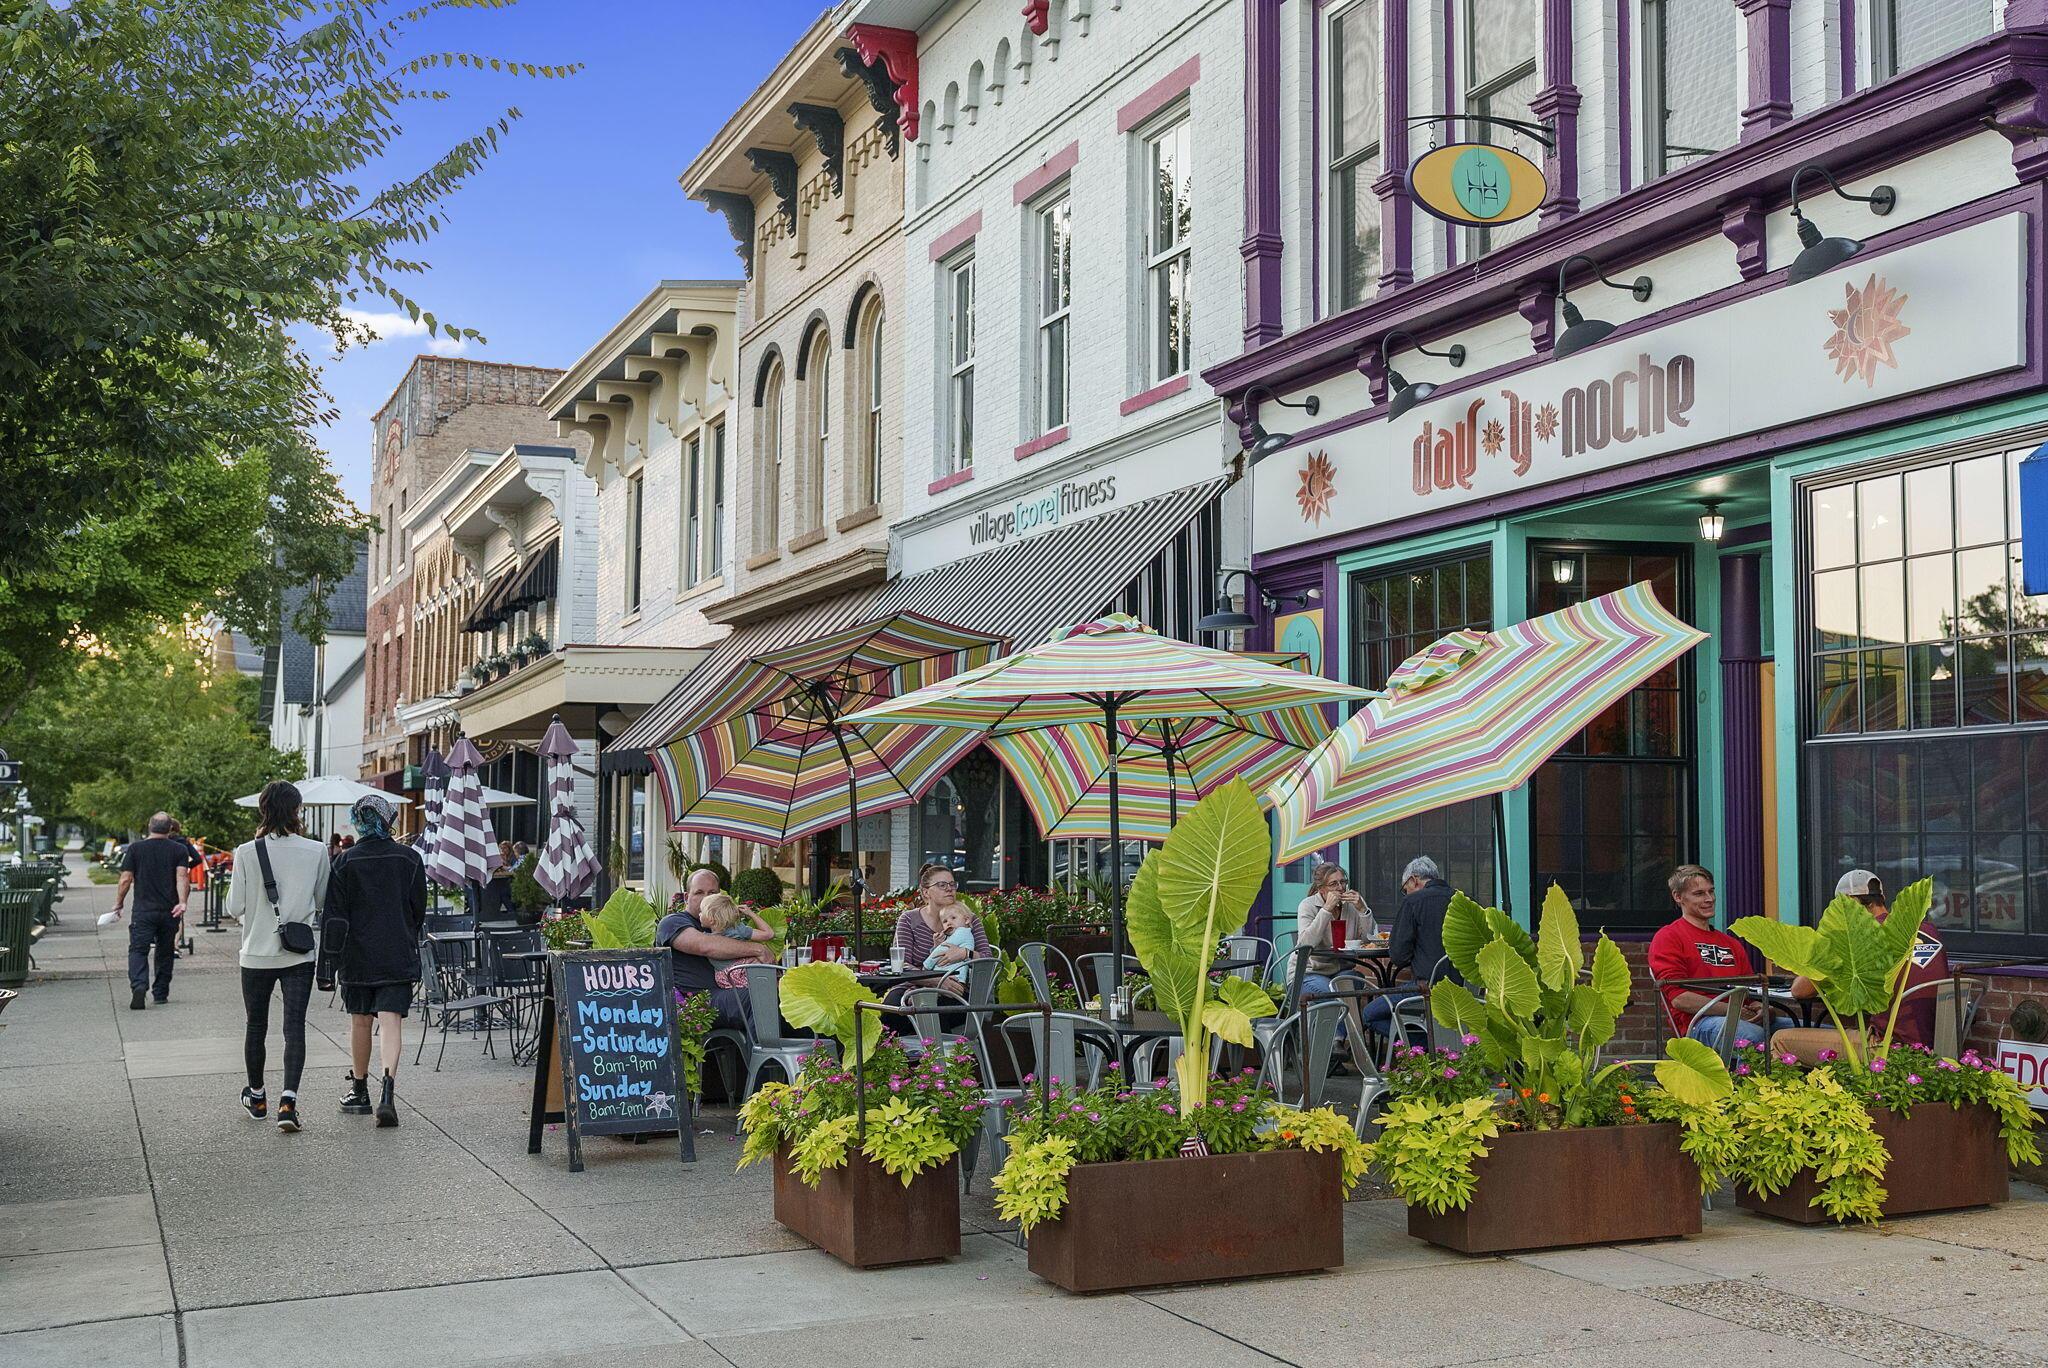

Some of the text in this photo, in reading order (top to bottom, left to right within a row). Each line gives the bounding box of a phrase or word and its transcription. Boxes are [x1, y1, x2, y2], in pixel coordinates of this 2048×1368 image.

[1561, 352, 1695, 457] noche
[1931, 892, 2016, 920] OPEN
[582, 963, 655, 991] HOURS
[577, 999, 664, 1028] Monday
[593, 1055, 658, 1076] 8am-9pm
[578, 1074, 652, 1101] Sunday
[588, 1101, 645, 1120] 8am-2pm
